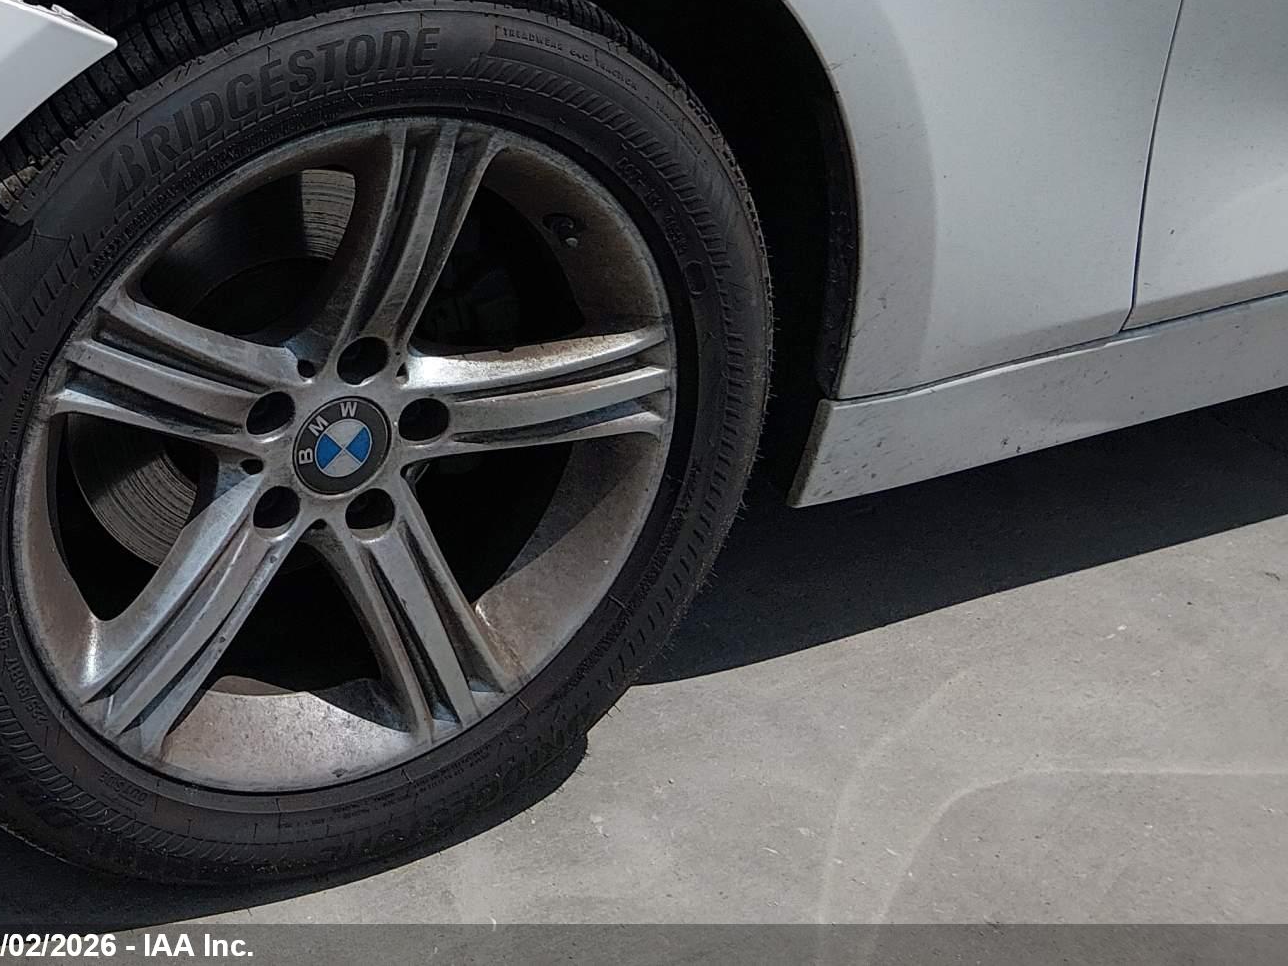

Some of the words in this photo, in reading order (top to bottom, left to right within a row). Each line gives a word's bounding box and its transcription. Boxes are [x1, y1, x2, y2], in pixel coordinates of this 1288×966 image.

[98, 27, 441, 196] BRIDGESTONE
[298, 401, 358, 465] BMW
[99, 770, 149, 805] OUTSIDE
